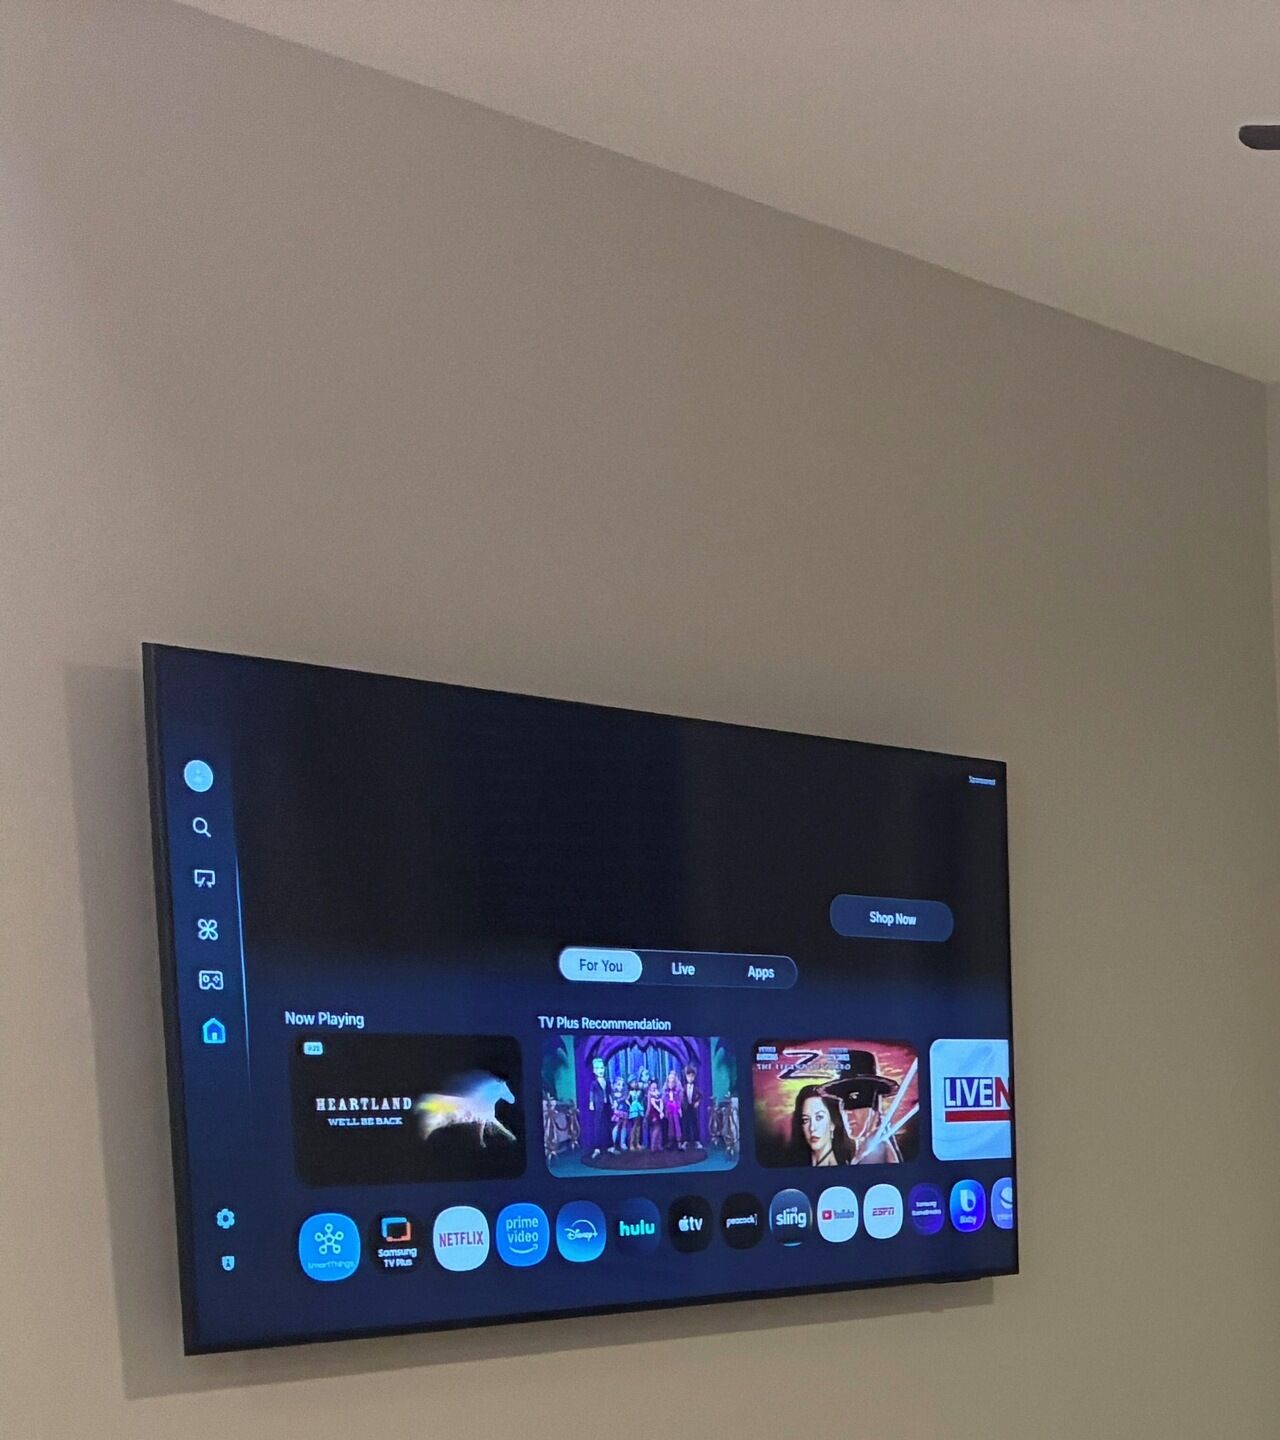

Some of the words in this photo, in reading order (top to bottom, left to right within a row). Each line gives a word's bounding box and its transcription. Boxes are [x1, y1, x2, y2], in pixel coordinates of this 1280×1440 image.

[869, 911, 894, 926] Shop
[895, 913, 917, 925] Now
[579, 958, 598, 971] For
[602, 959, 623, 973] You
[671, 962, 696, 976] Live
[747, 965, 775, 981] Apps
[285, 1011, 315, 1025] Now
[318, 1012, 365, 1029] Playing
[538, 1016, 554, 1029] TV
[556, 1016, 579, 1029] Plus
[581, 1017, 672, 1031] Recommendation
[316, 1097, 412, 1111] HEARTLAND
[375, 1117, 403, 1126] BACK
[505, 1216, 539, 1231] prime
[776, 1209, 807, 1228] sling
[619, 1219, 655, 1236] hulu
[439, 1231, 484, 1248] NETFLIX
[507, 1230, 539, 1244] video
[378, 1247, 417, 1258] Samsung
[384, 1259, 394, 1268] TV
[396, 1258, 413, 1267] Plus
